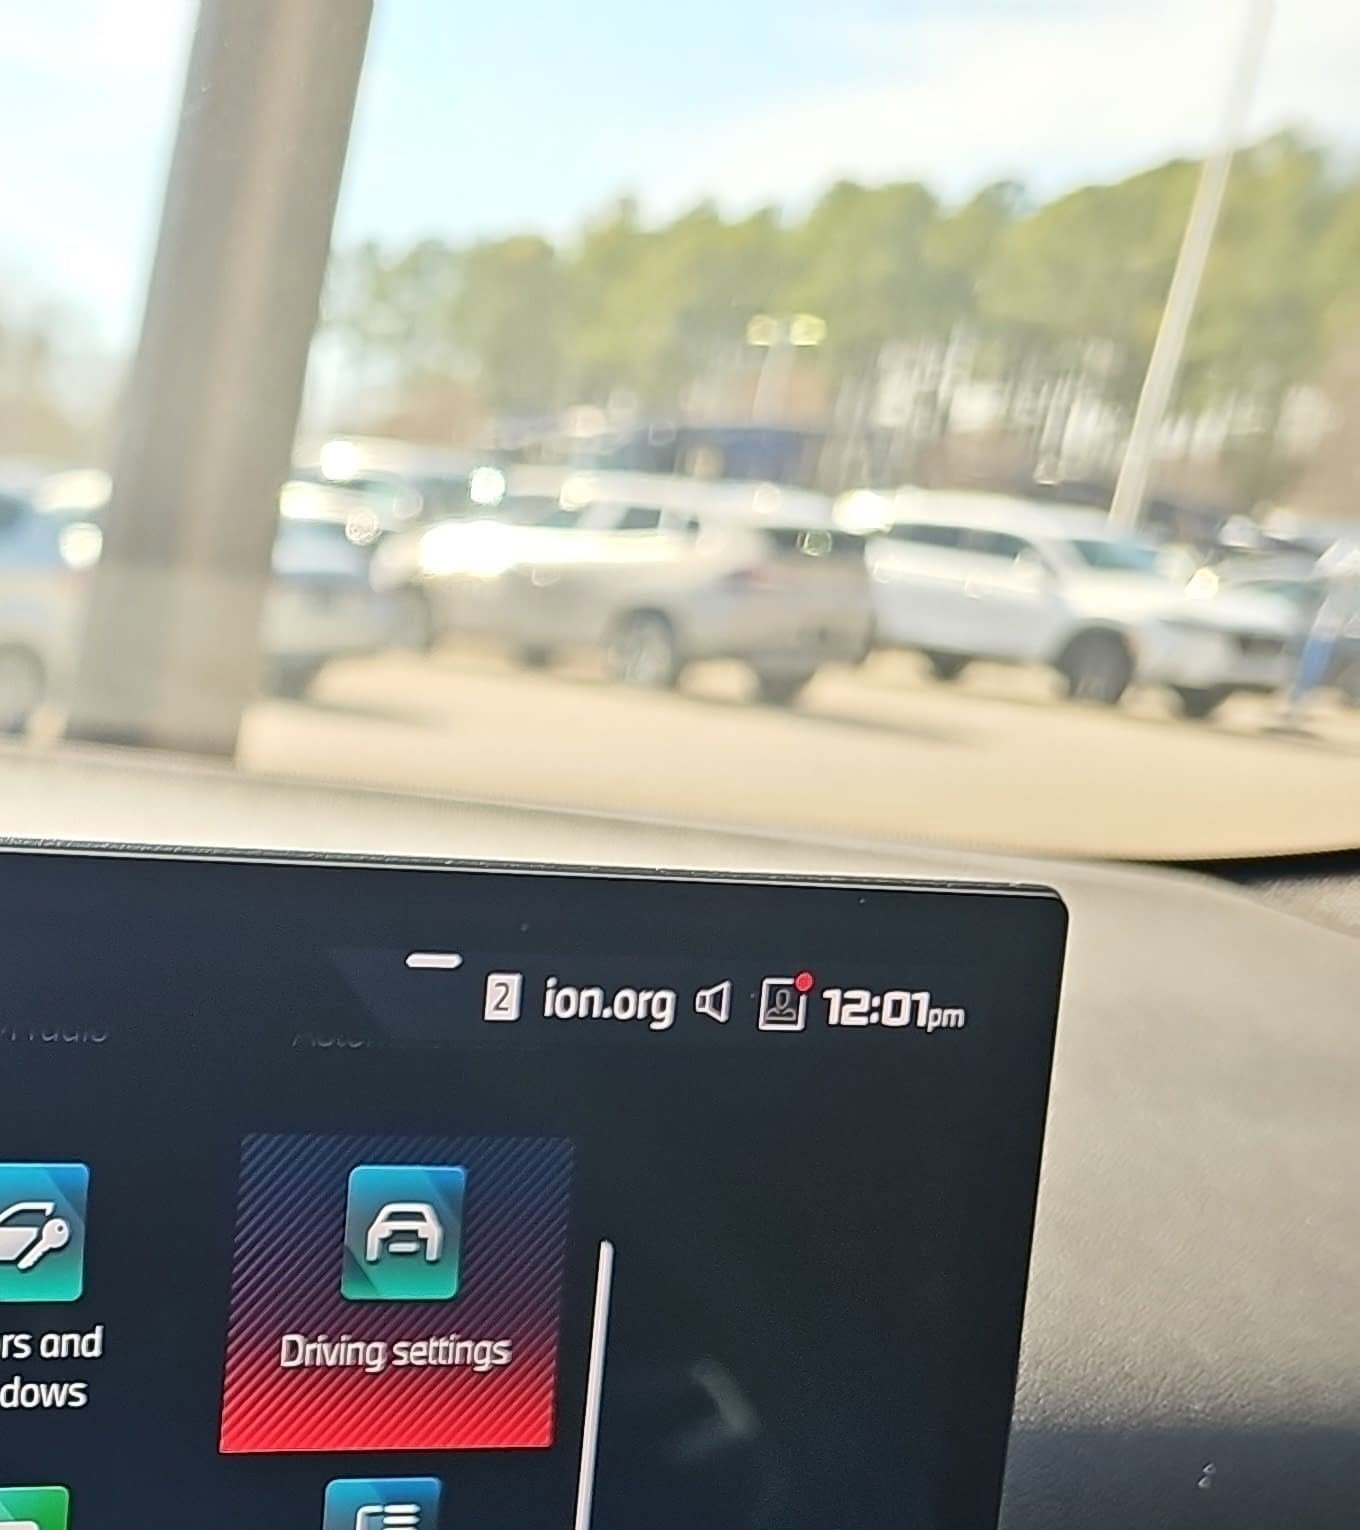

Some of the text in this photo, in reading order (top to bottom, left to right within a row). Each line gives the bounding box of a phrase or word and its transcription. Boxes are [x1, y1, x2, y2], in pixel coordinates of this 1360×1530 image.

[543, 976, 677, 1031] ion.org
[39, 1324, 104, 1359] and
[279, 1332, 513, 1373] Driving settings
